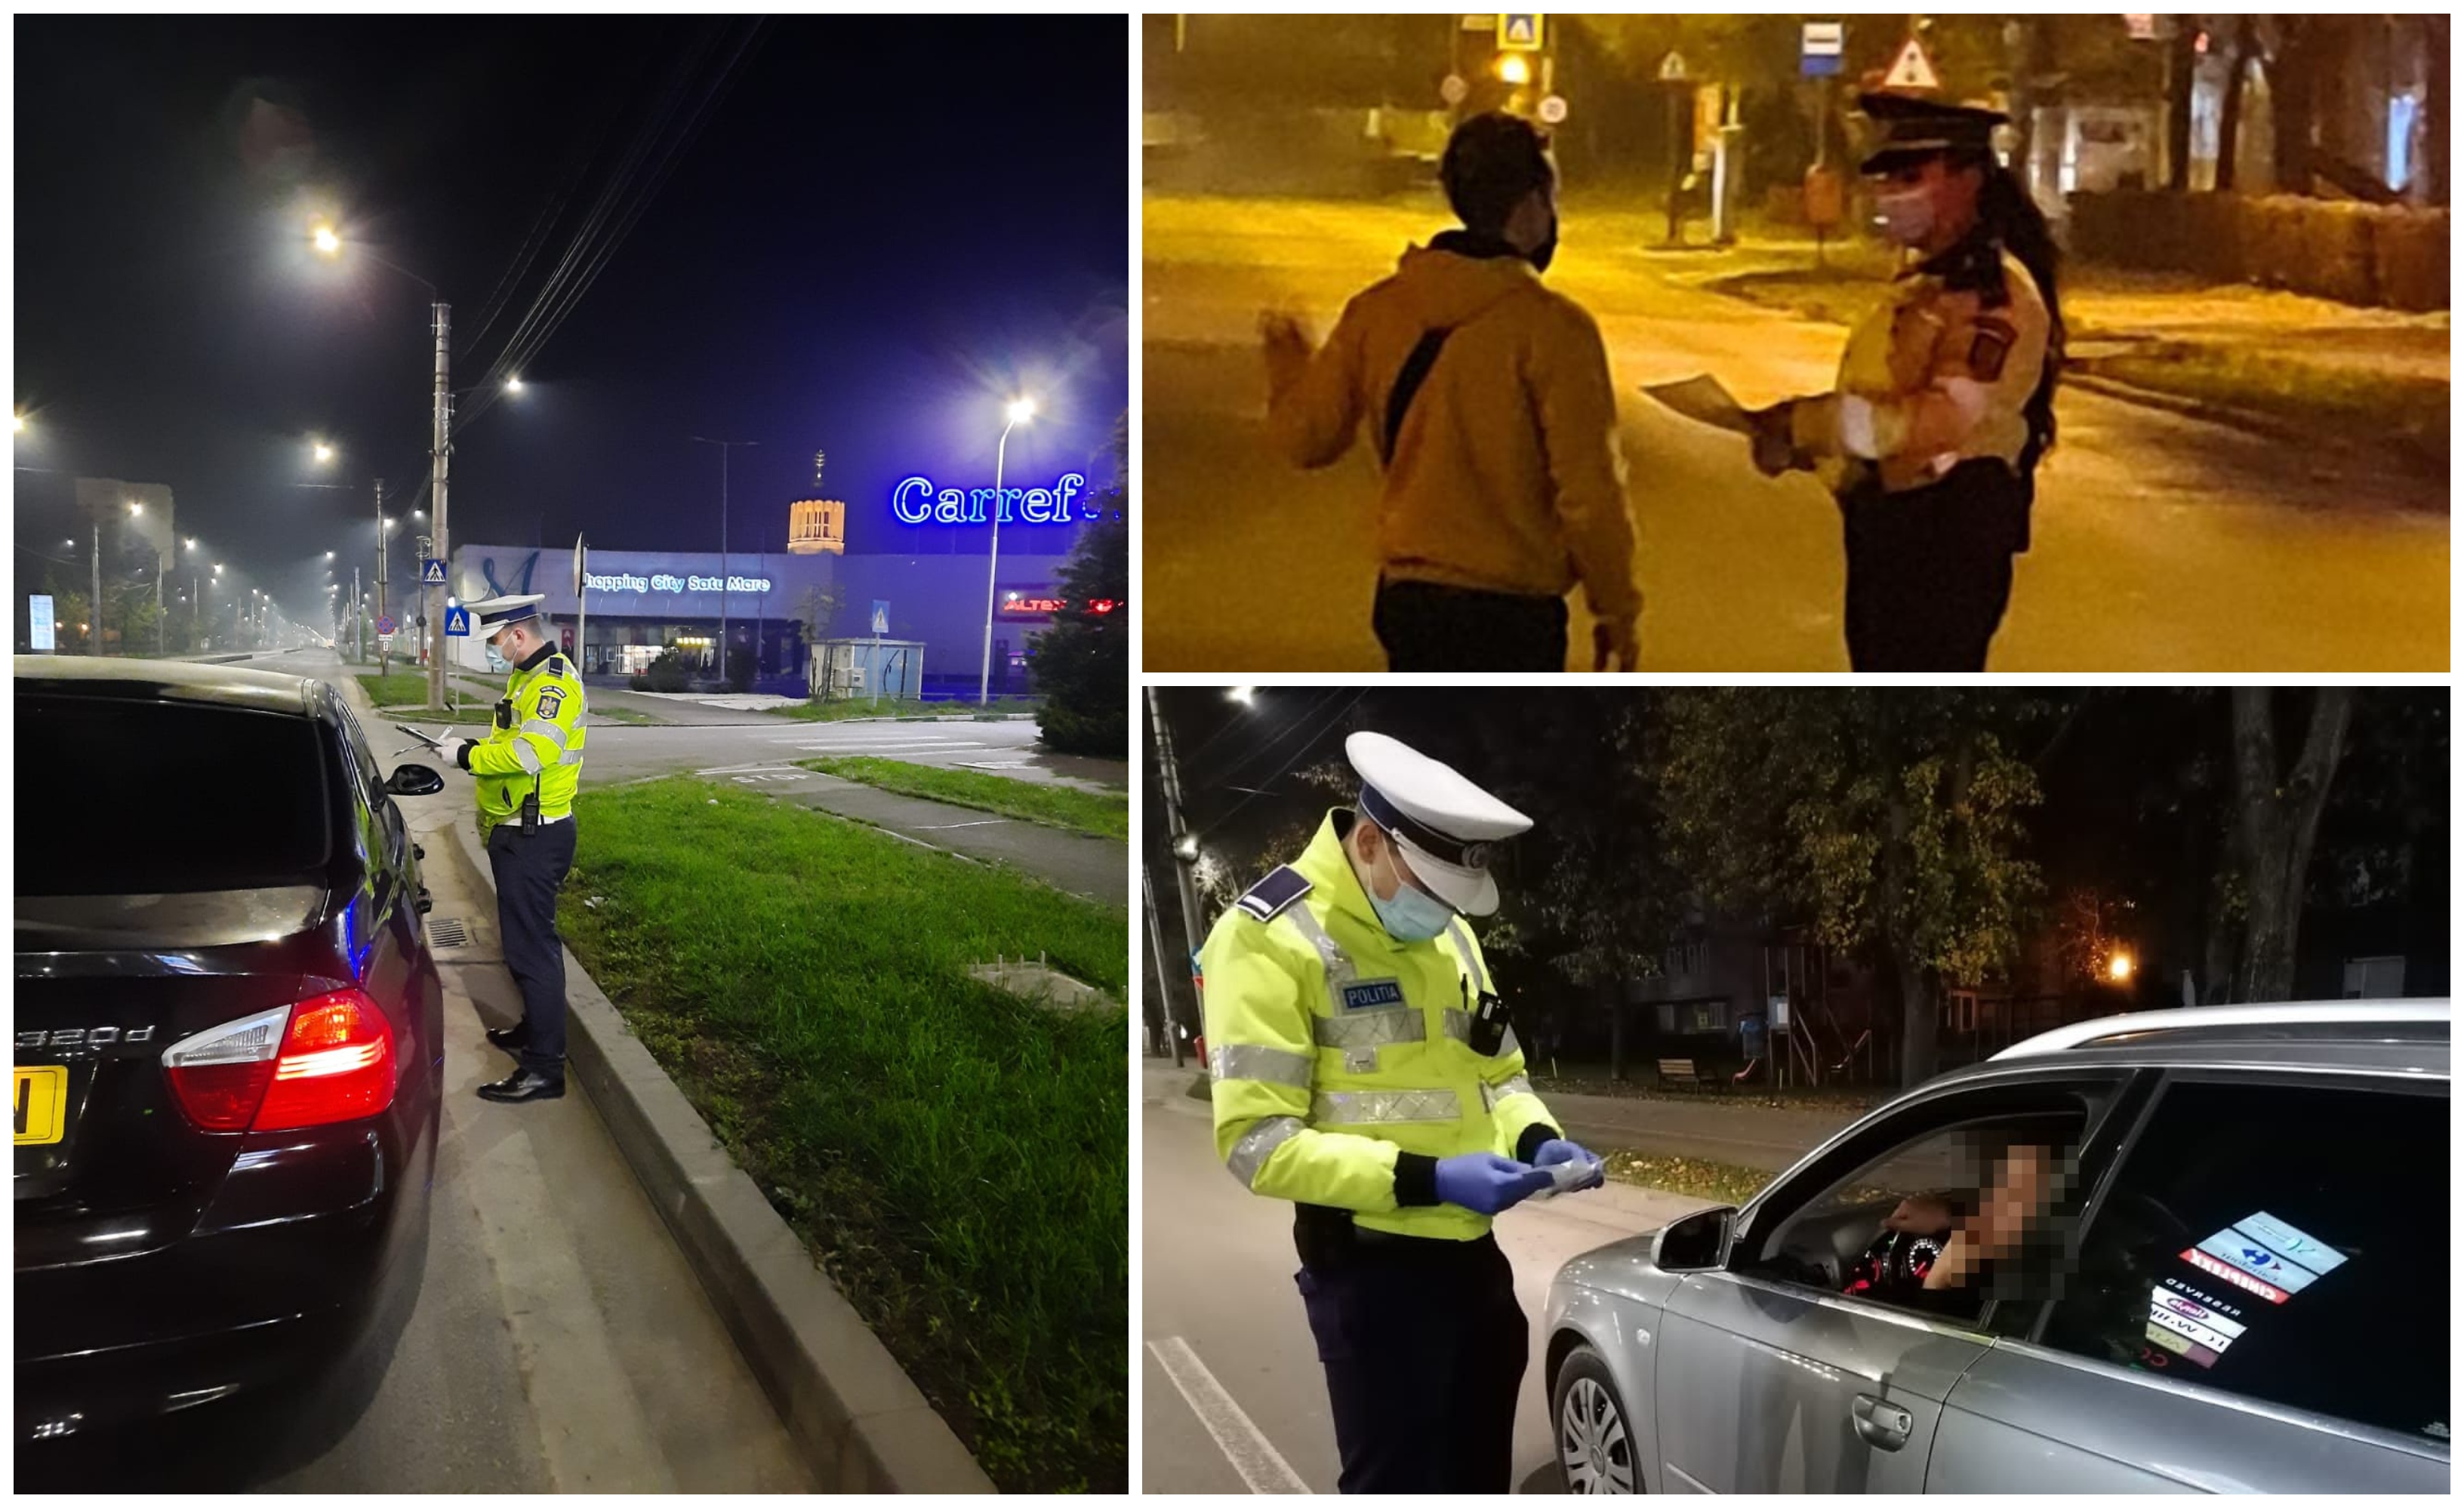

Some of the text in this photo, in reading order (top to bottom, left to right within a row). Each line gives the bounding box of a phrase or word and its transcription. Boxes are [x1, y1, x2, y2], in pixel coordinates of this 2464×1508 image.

[893, 472, 1121, 524] Carref
[585, 573, 771, 592] hopping City Satu Mare
[14, 1024, 156, 1046] 320d
